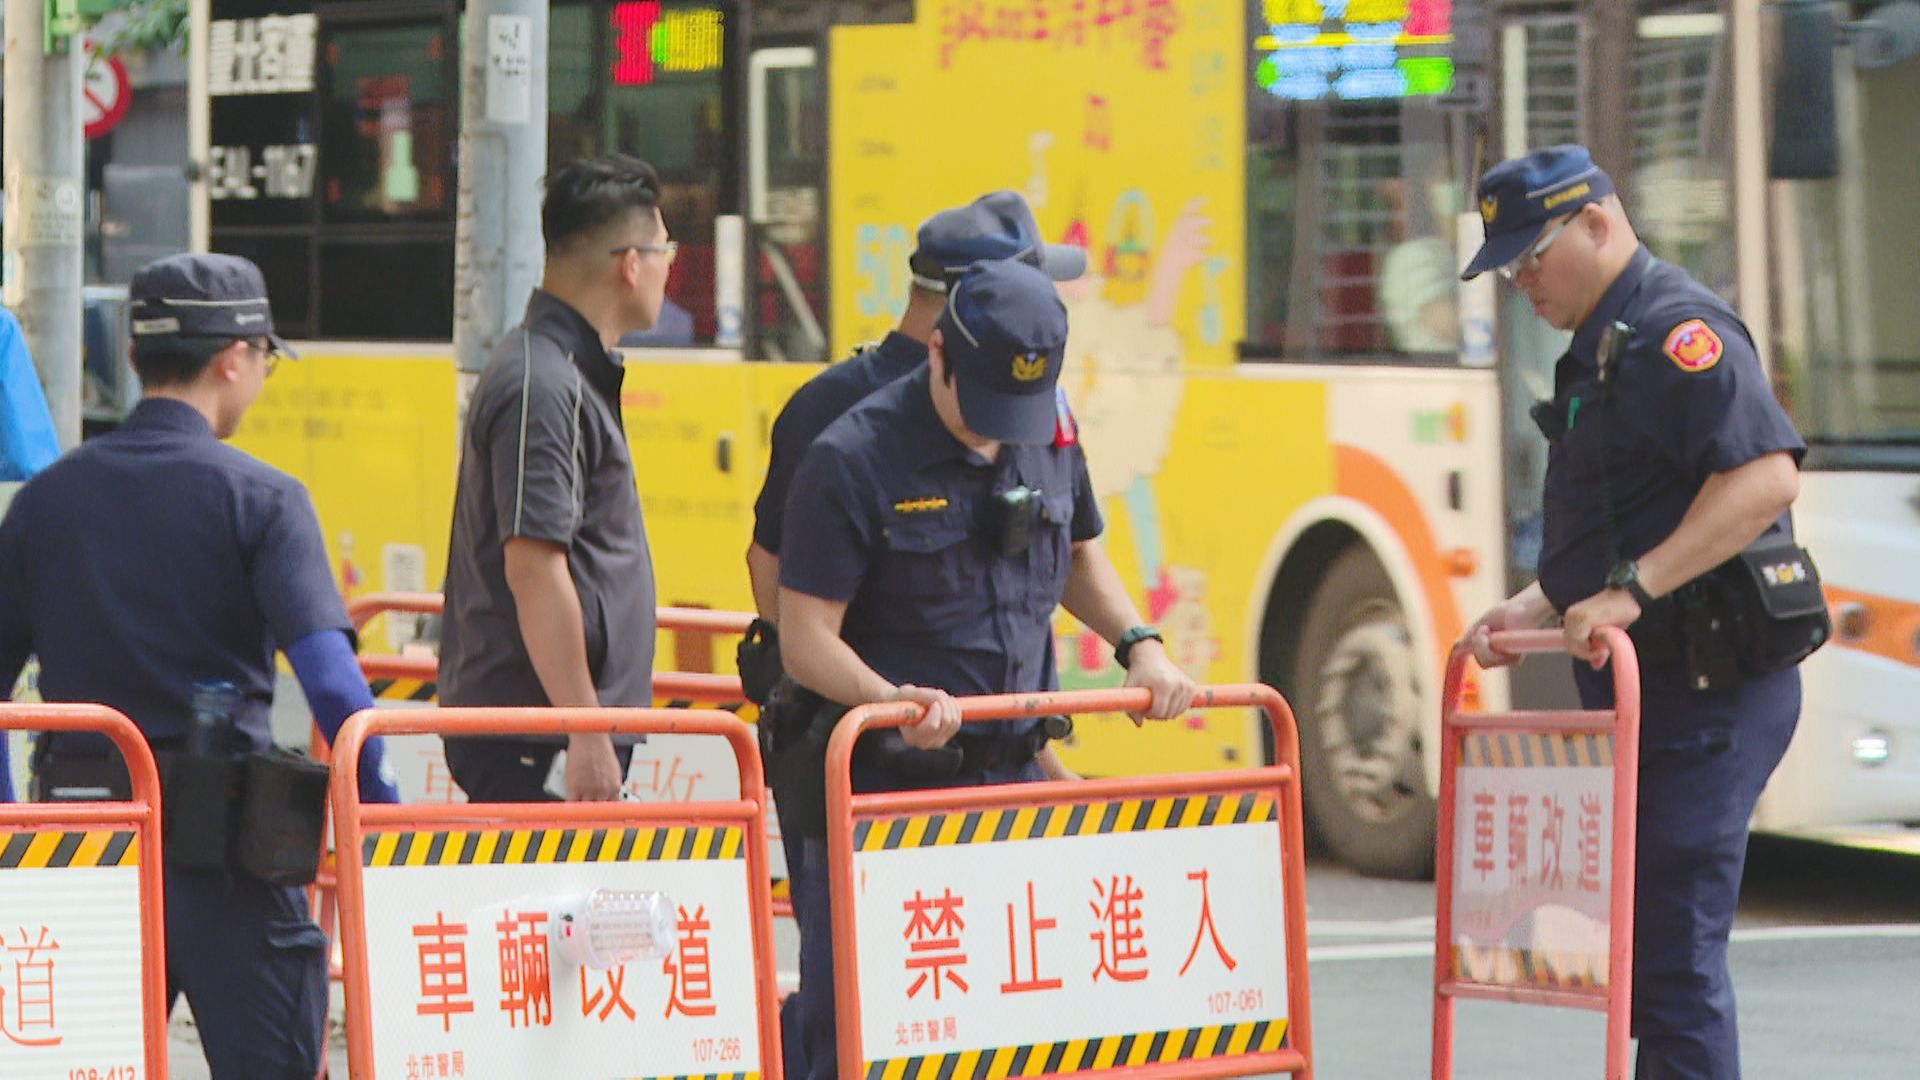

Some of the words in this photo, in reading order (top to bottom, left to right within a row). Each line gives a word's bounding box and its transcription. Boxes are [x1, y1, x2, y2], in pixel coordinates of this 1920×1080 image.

[902, 868, 1238, 1001] 禁止進入
[0, 925, 64, 1047] 道
[1207, 988, 1265, 1014] 107-061
[895, 1016, 958, 1045] 北市警局
[692, 1037, 742, 1062] 107-266
[406, 1050, 465, 1079] 北市警局
